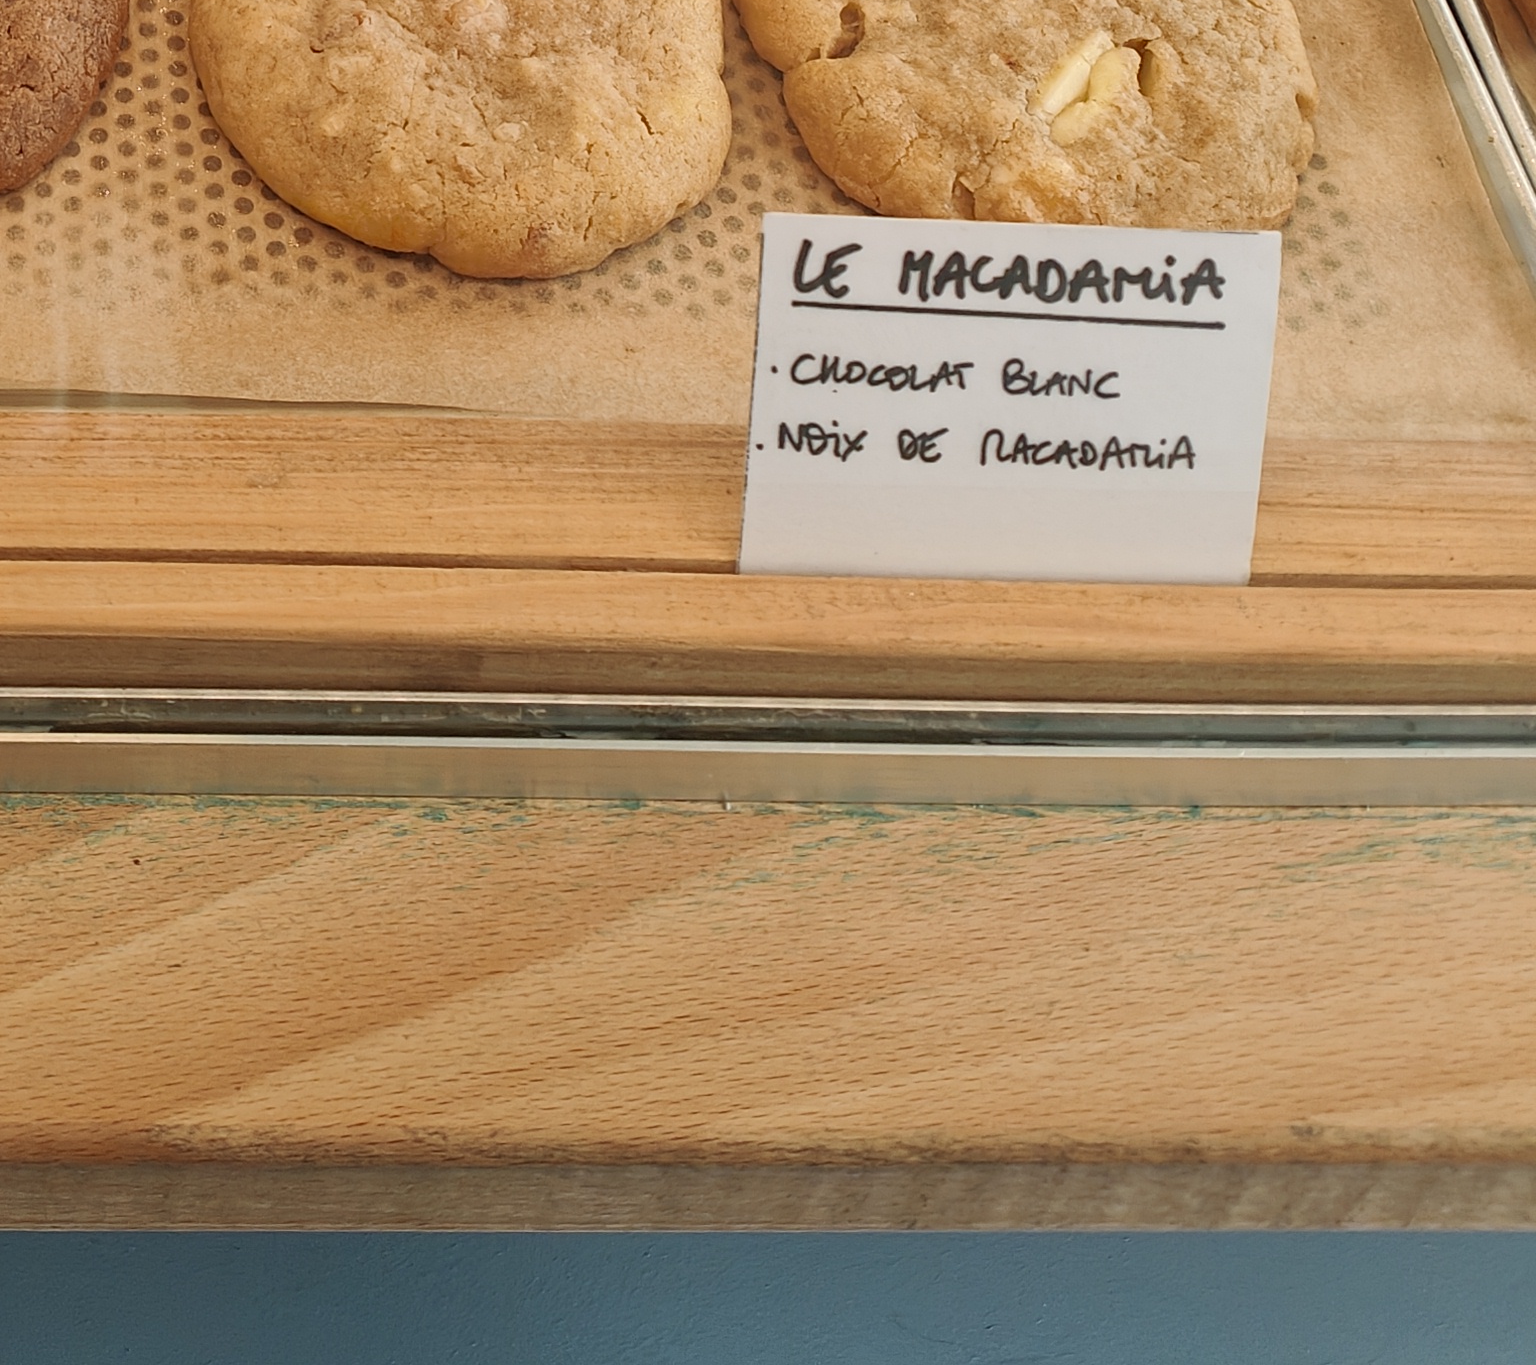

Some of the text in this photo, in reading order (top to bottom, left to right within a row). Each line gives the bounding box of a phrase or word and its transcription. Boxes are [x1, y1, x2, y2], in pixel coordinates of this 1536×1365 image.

[792, 239, 862, 298] LE
[790, 353, 1120, 399] CHOCOLAT BLANC
[898, 427, 949, 463] DE
